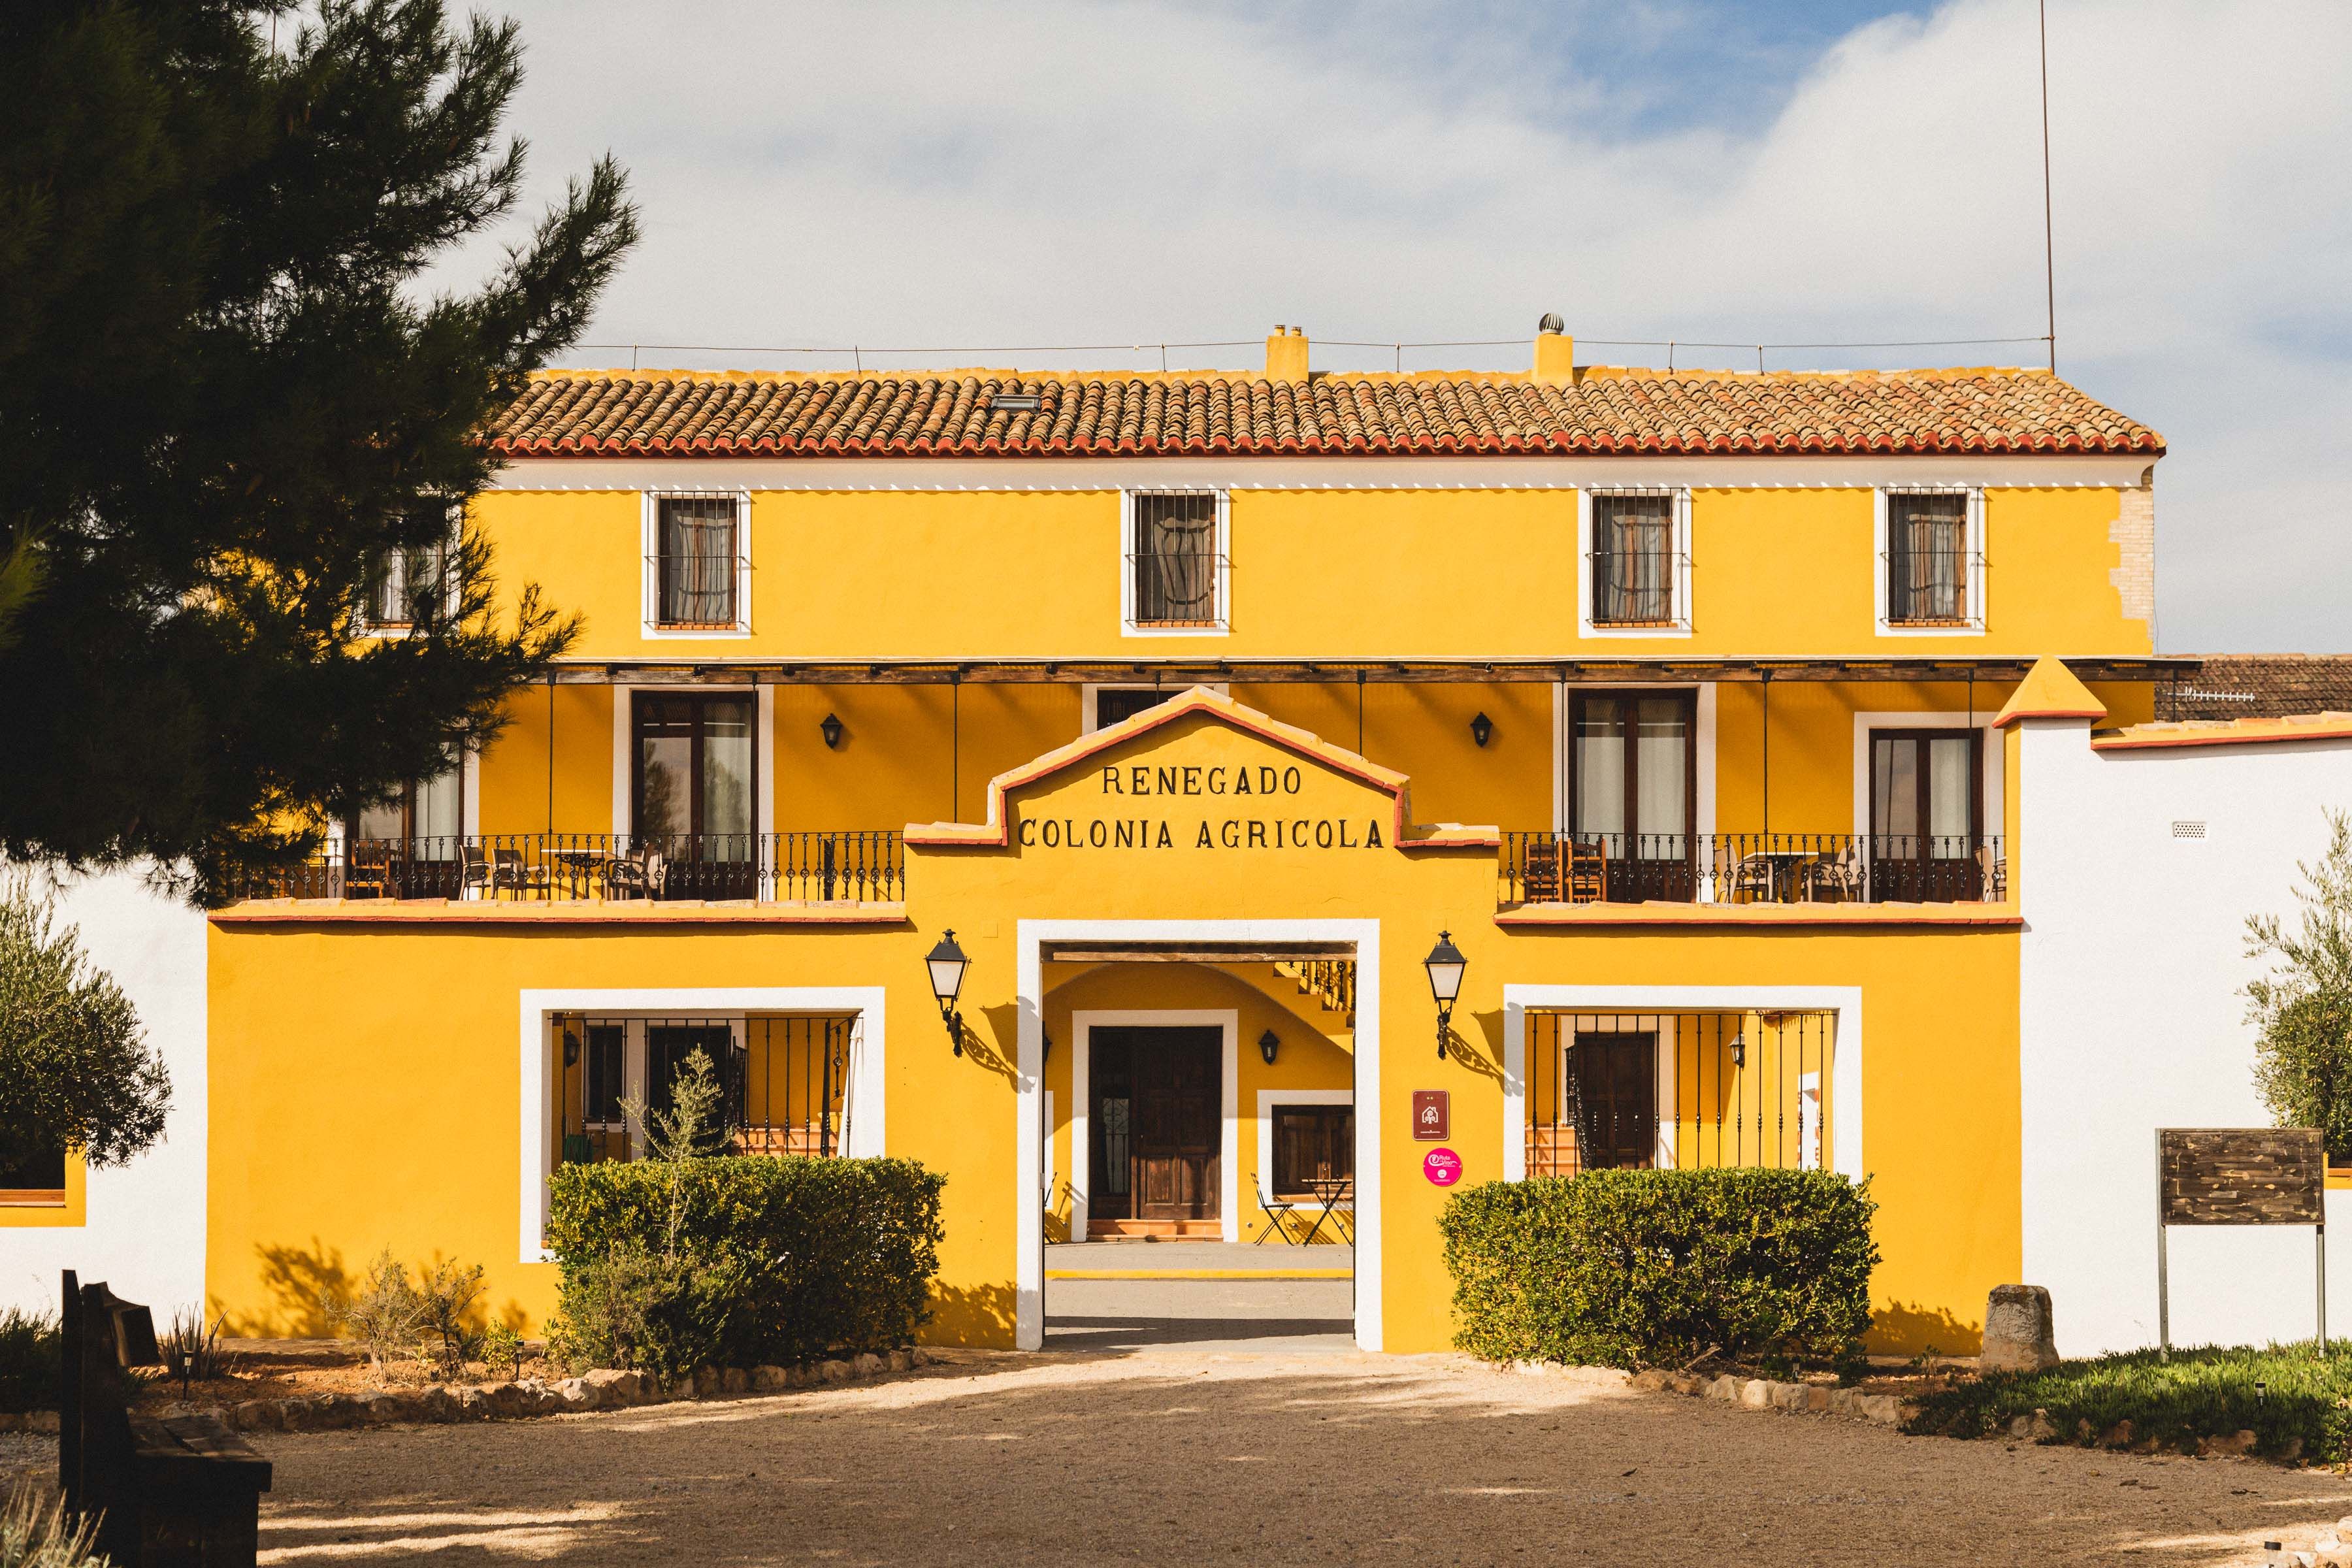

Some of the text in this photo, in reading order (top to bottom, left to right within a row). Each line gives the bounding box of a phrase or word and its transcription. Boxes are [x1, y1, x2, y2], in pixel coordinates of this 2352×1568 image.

[1102, 766, 1301, 794] RENEGADO
[1019, 819, 1384, 848] COLONIA AGRICOLA
